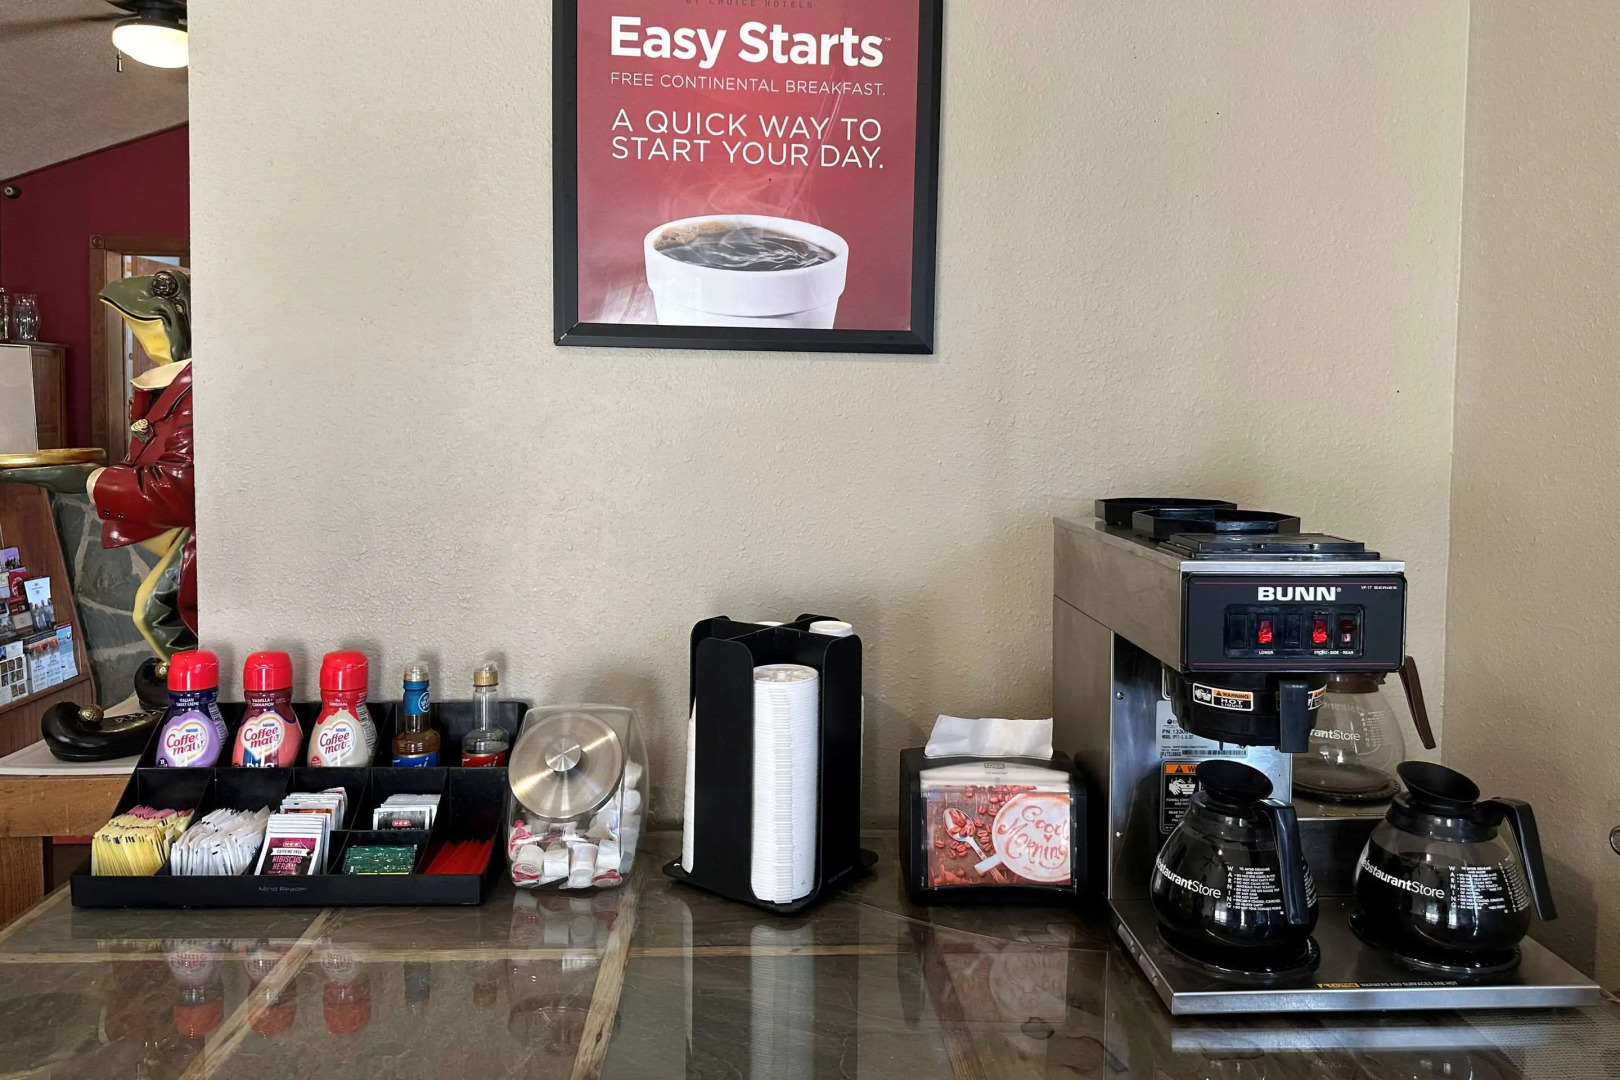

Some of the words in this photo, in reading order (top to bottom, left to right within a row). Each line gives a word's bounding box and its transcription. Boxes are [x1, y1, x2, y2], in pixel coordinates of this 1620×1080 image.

[764, 0, 813, 9] HOTELS
[611, 15, 727, 69] Easy
[738, 21, 884, 67] Starts
[611, 72, 654, 87] FREE
[660, 75, 779, 92] CONTINENTAL
[785, 80, 886, 96] BREAKFAST.
[611, 108, 633, 132] A
[645, 110, 747, 137] QUICK
[759, 114, 829, 140] WAY
[841, 118, 882, 142] TO
[611, 136, 711, 163] START
[722, 140, 809, 166] YOUR
[820, 145, 884, 169] DAY.
[1257, 586, 1337, 601] BUNN
[1222, 692, 1250, 700] WARNING
[244, 726, 279, 742] Coffee
[250, 734, 280, 749] mate
[320, 731, 350, 748] Coffee
[1021, 804, 1069, 841] Good
[272, 855, 303, 864] HIBISCUS
[1156, 857, 1221, 898] bstaurantStore
[1226, 865, 1234, 909] WARNING
[1448, 865, 1457, 908] WARNING
